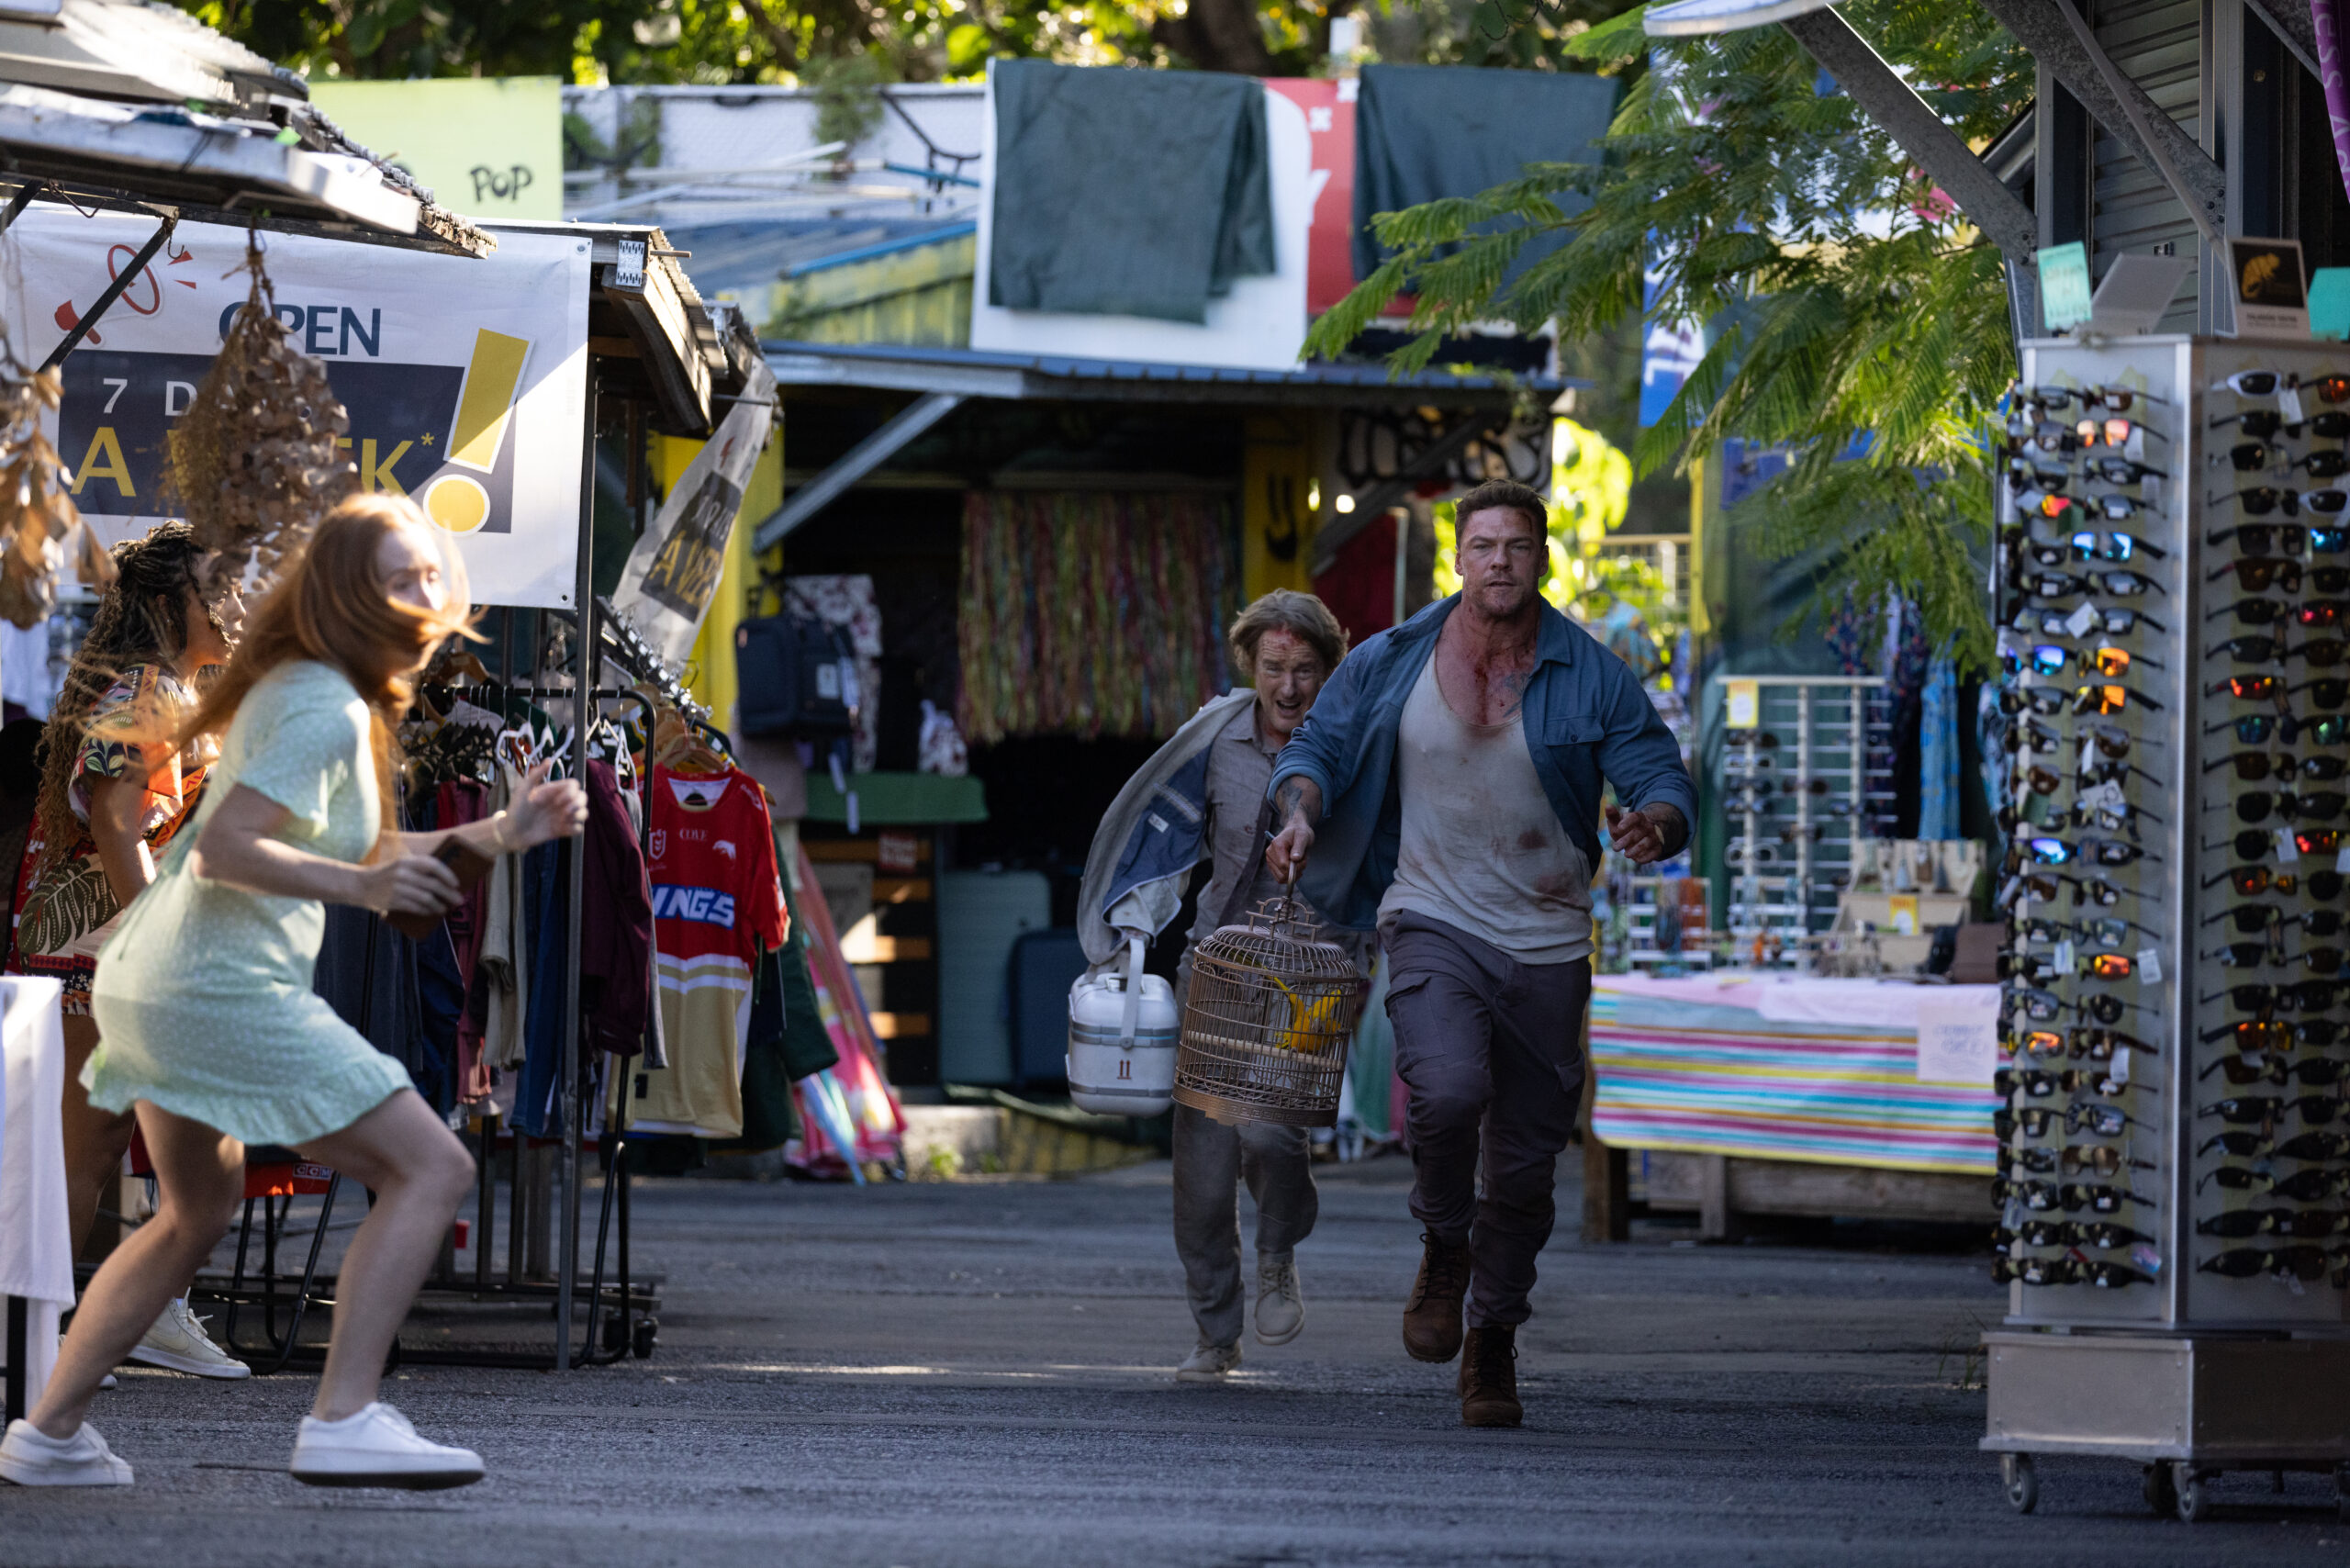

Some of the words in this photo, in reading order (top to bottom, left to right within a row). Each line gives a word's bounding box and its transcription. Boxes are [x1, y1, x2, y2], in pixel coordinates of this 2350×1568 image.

[103, 377, 128, 414] 7
[71, 426, 137, 497] A
[648, 530, 687, 588] A
[653, 887, 735, 927] INGS
[295, 1164, 330, 1178] CCM
